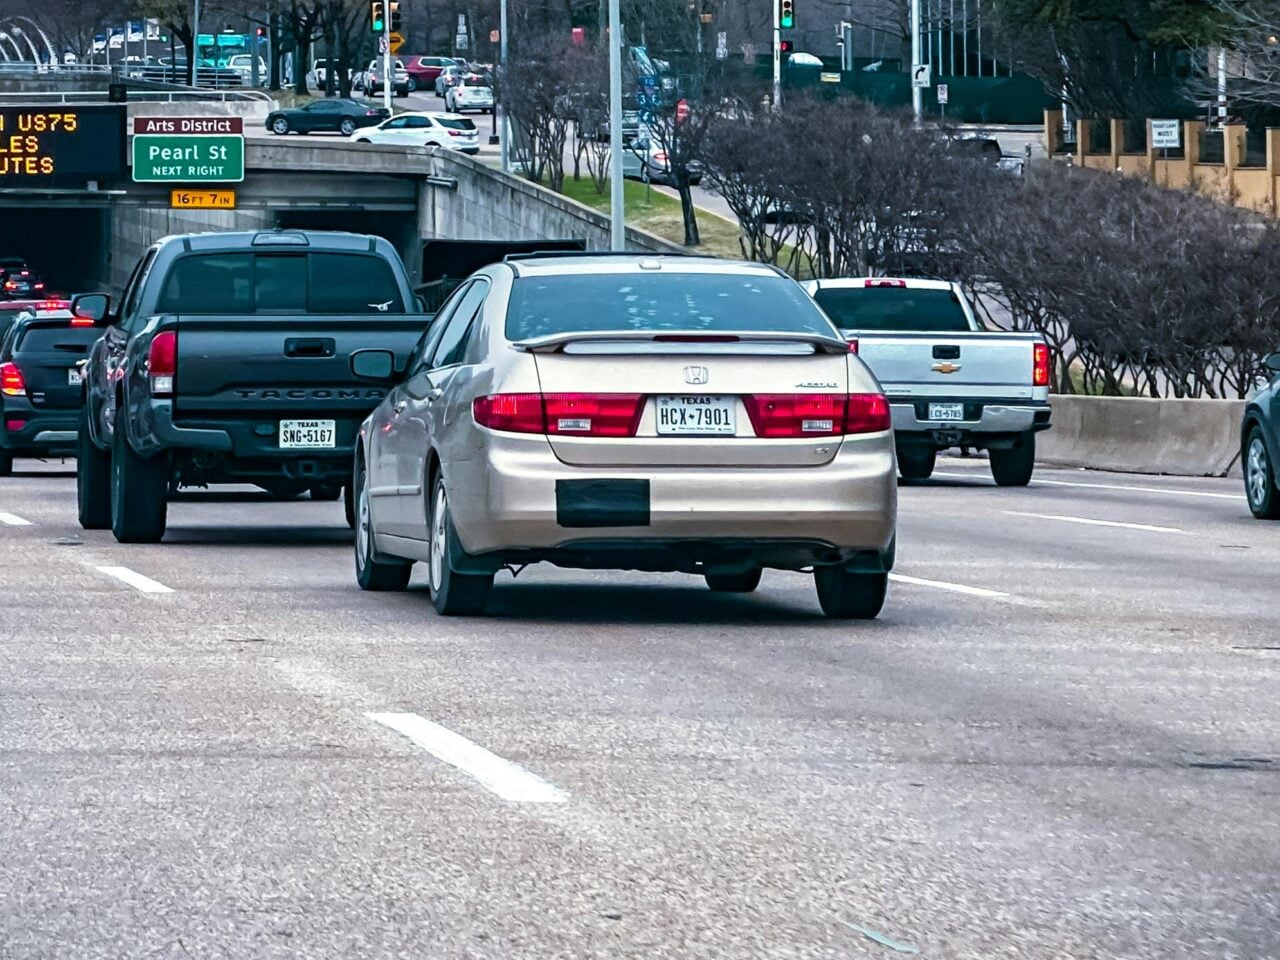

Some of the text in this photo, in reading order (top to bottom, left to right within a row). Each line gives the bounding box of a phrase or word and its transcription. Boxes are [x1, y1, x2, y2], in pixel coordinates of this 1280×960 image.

[18, 114, 77, 131] US75
[146, 120, 231, 132] Arts District
[149, 145, 227, 160] Pearl St
[152, 166, 224, 175] NEXT RIGHT
[234, 389, 387, 400] TACOMA
[681, 397, 711, 405] TEXAS
